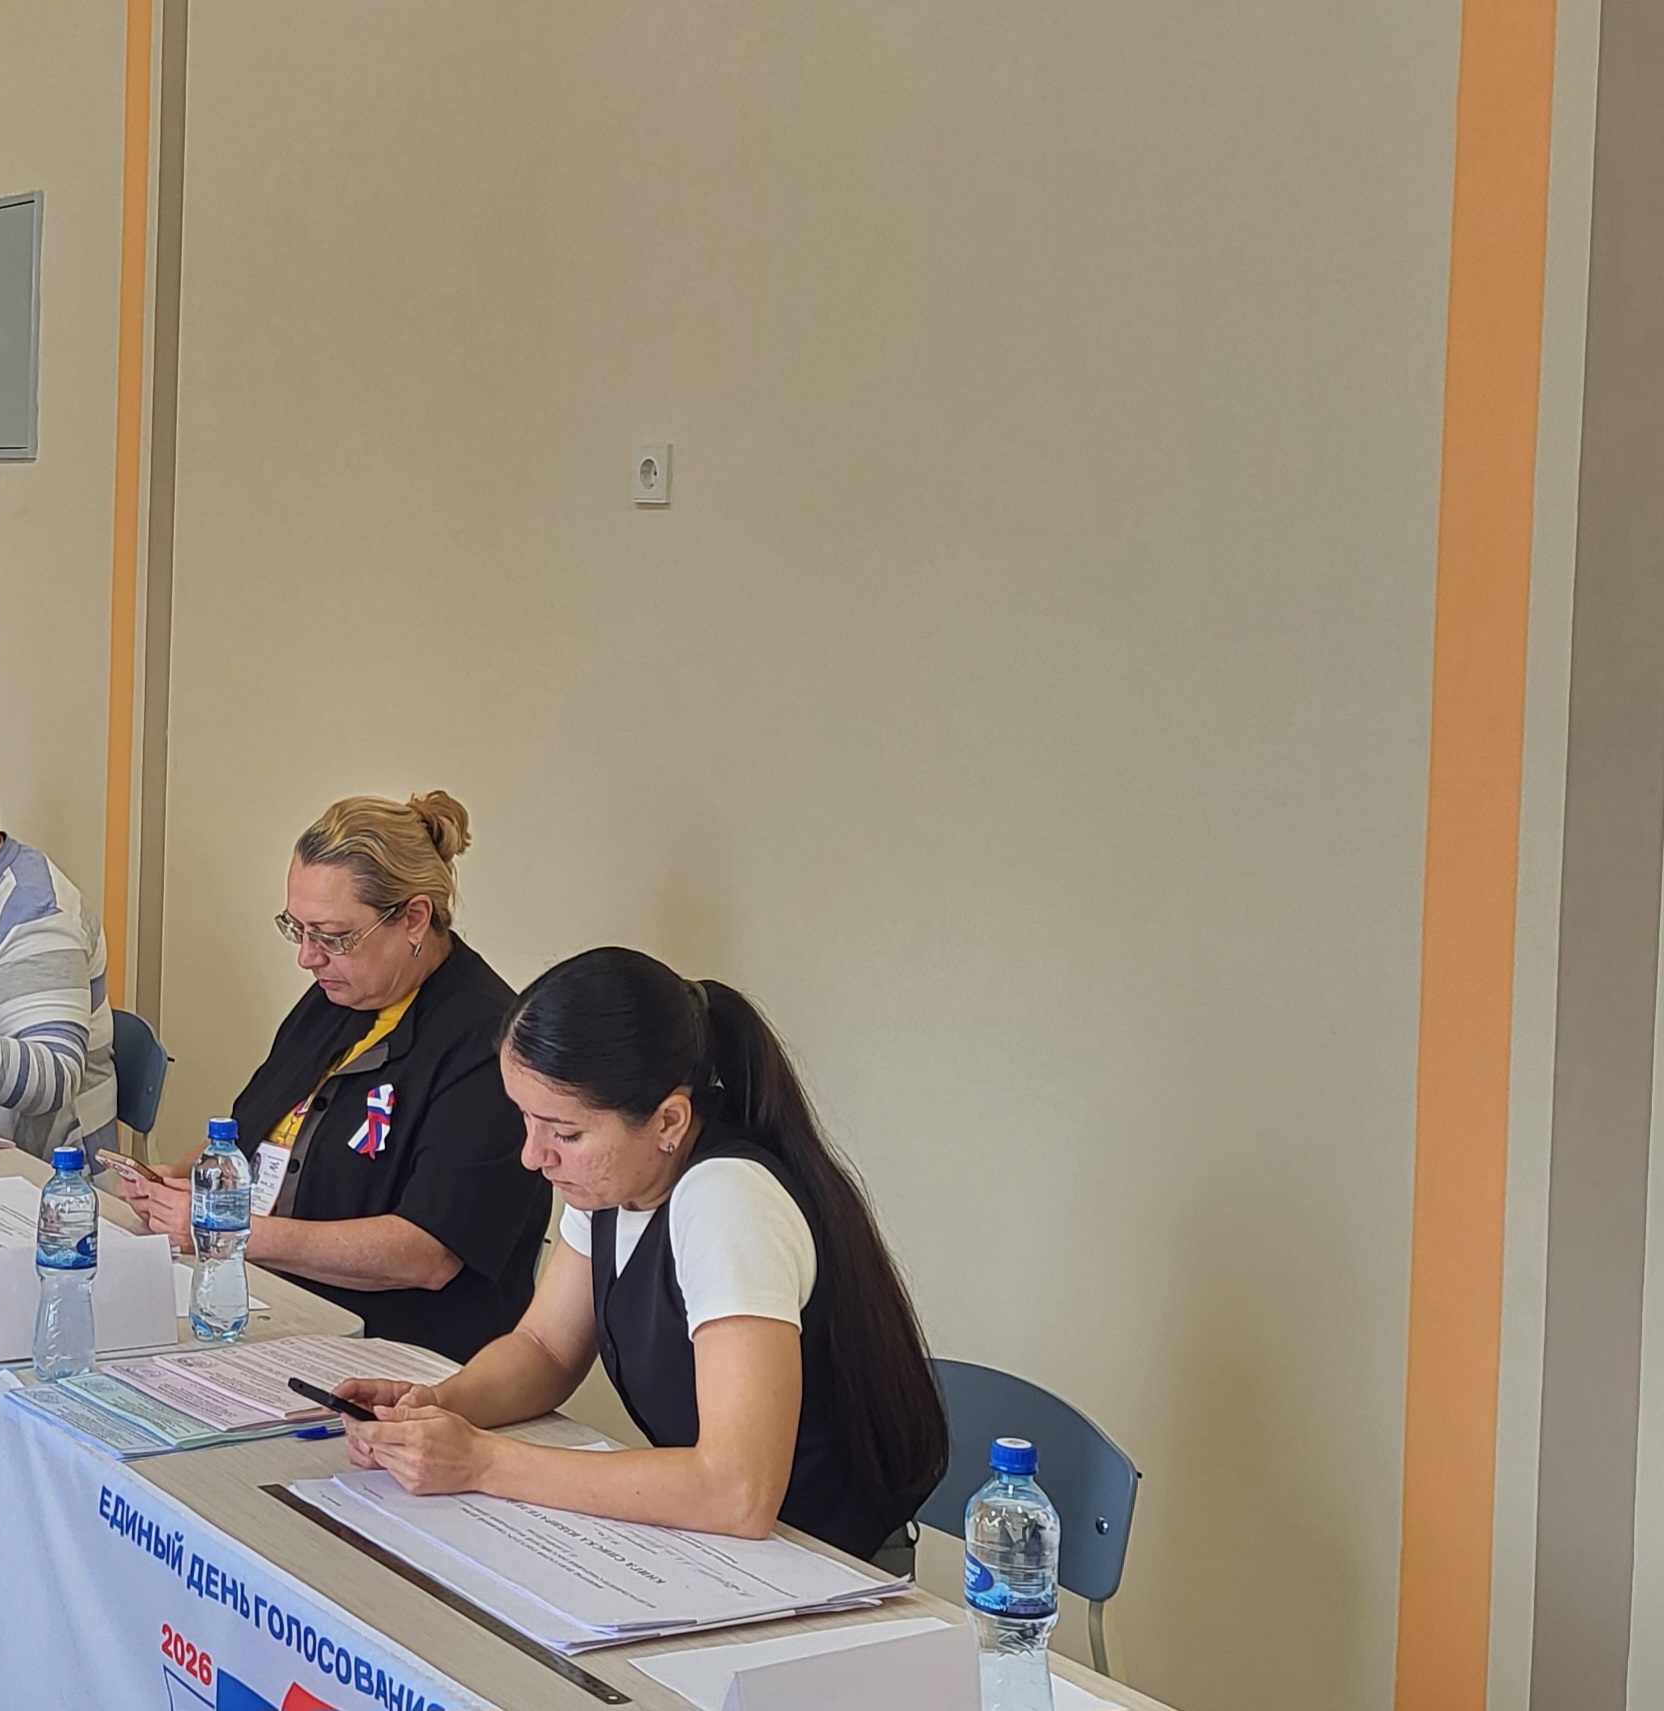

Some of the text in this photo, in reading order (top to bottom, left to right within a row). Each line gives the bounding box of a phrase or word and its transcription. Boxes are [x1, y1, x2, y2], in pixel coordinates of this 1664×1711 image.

[99, 1484, 446, 1711] ЕДИНЫЙ ДЕНЬ ГОЛОСОВАНИ
[625, 1561, 667, 1584] КНИГА
[161, 1623, 213, 1686] 2026
